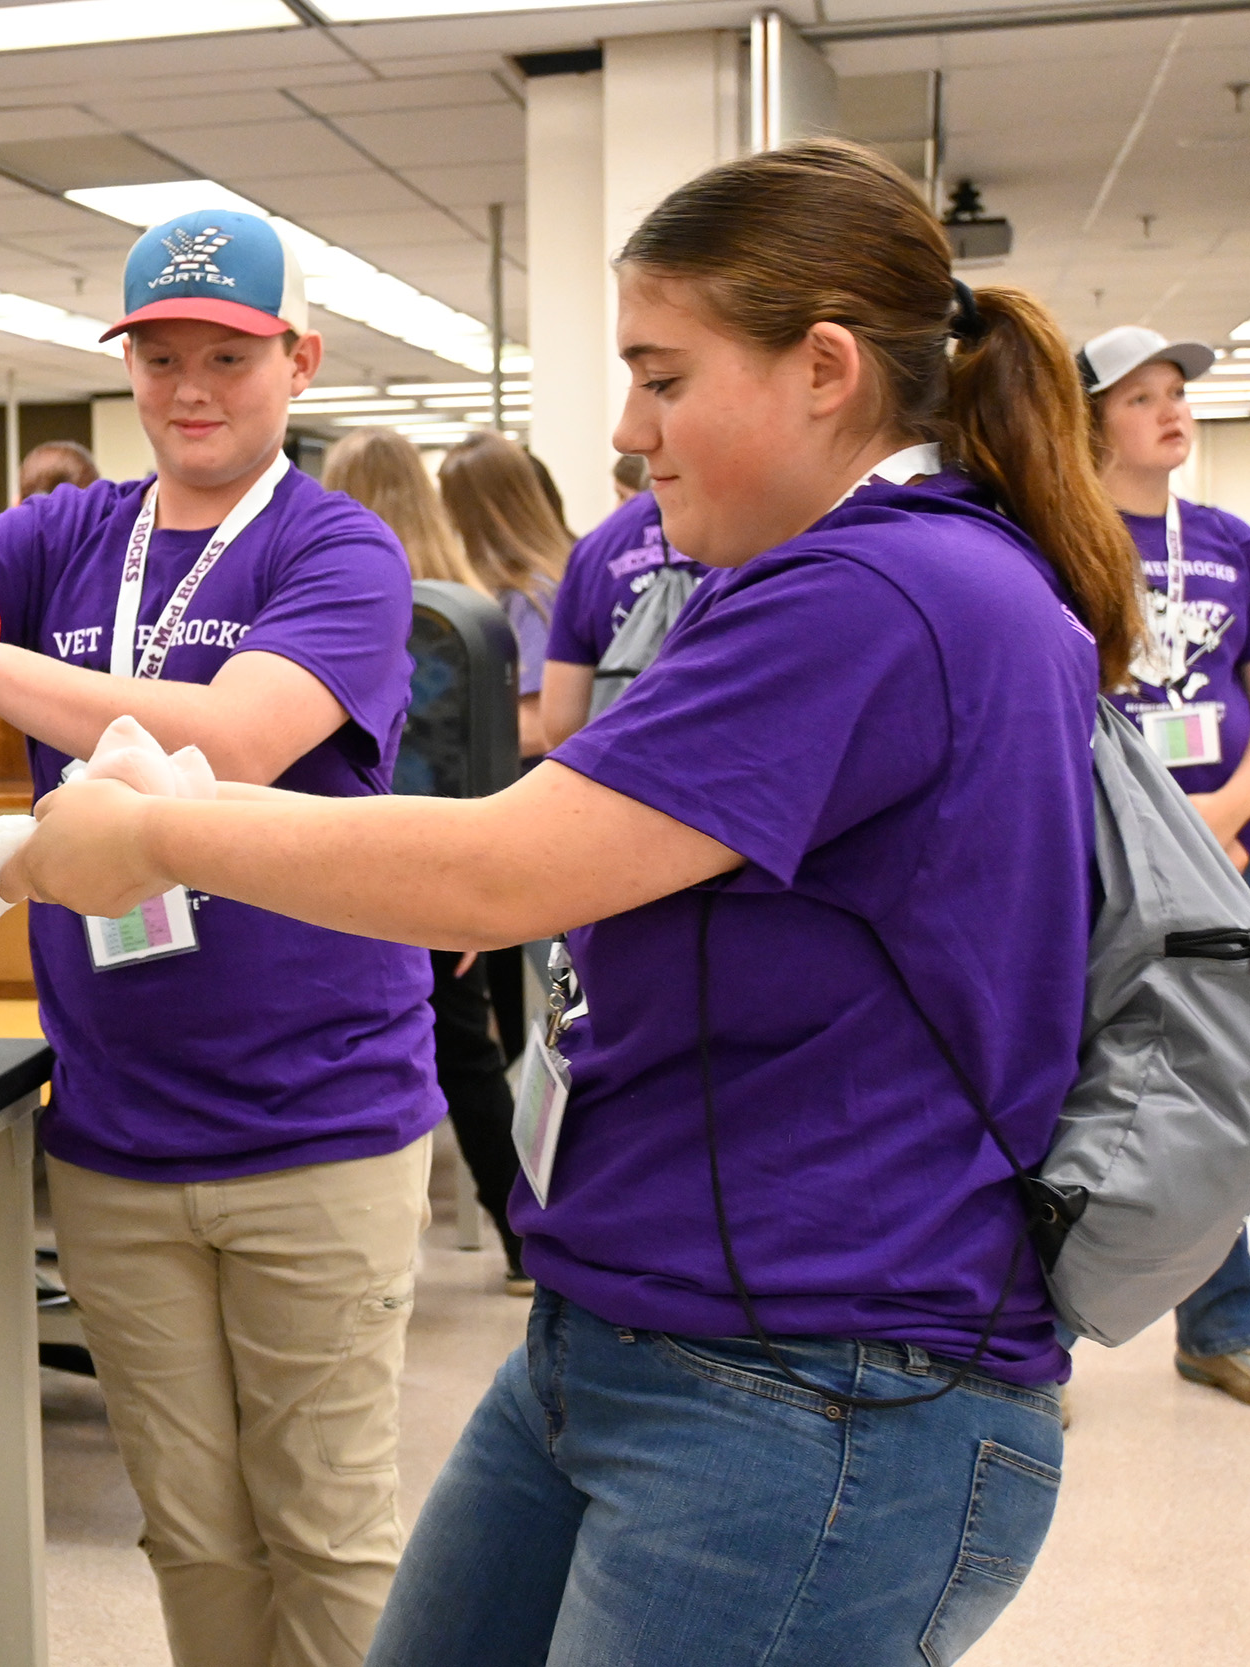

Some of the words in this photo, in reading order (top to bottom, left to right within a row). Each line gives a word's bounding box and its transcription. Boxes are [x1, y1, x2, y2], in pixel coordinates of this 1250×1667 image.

[148, 271, 236, 289] VORTEX
[125, 521, 150, 583] ROCKS
[1182, 560, 1236, 583] ROCKS
[152, 605, 183, 650] Med
[177, 540, 225, 600] ROCKS
[52, 625, 103, 658] VET
